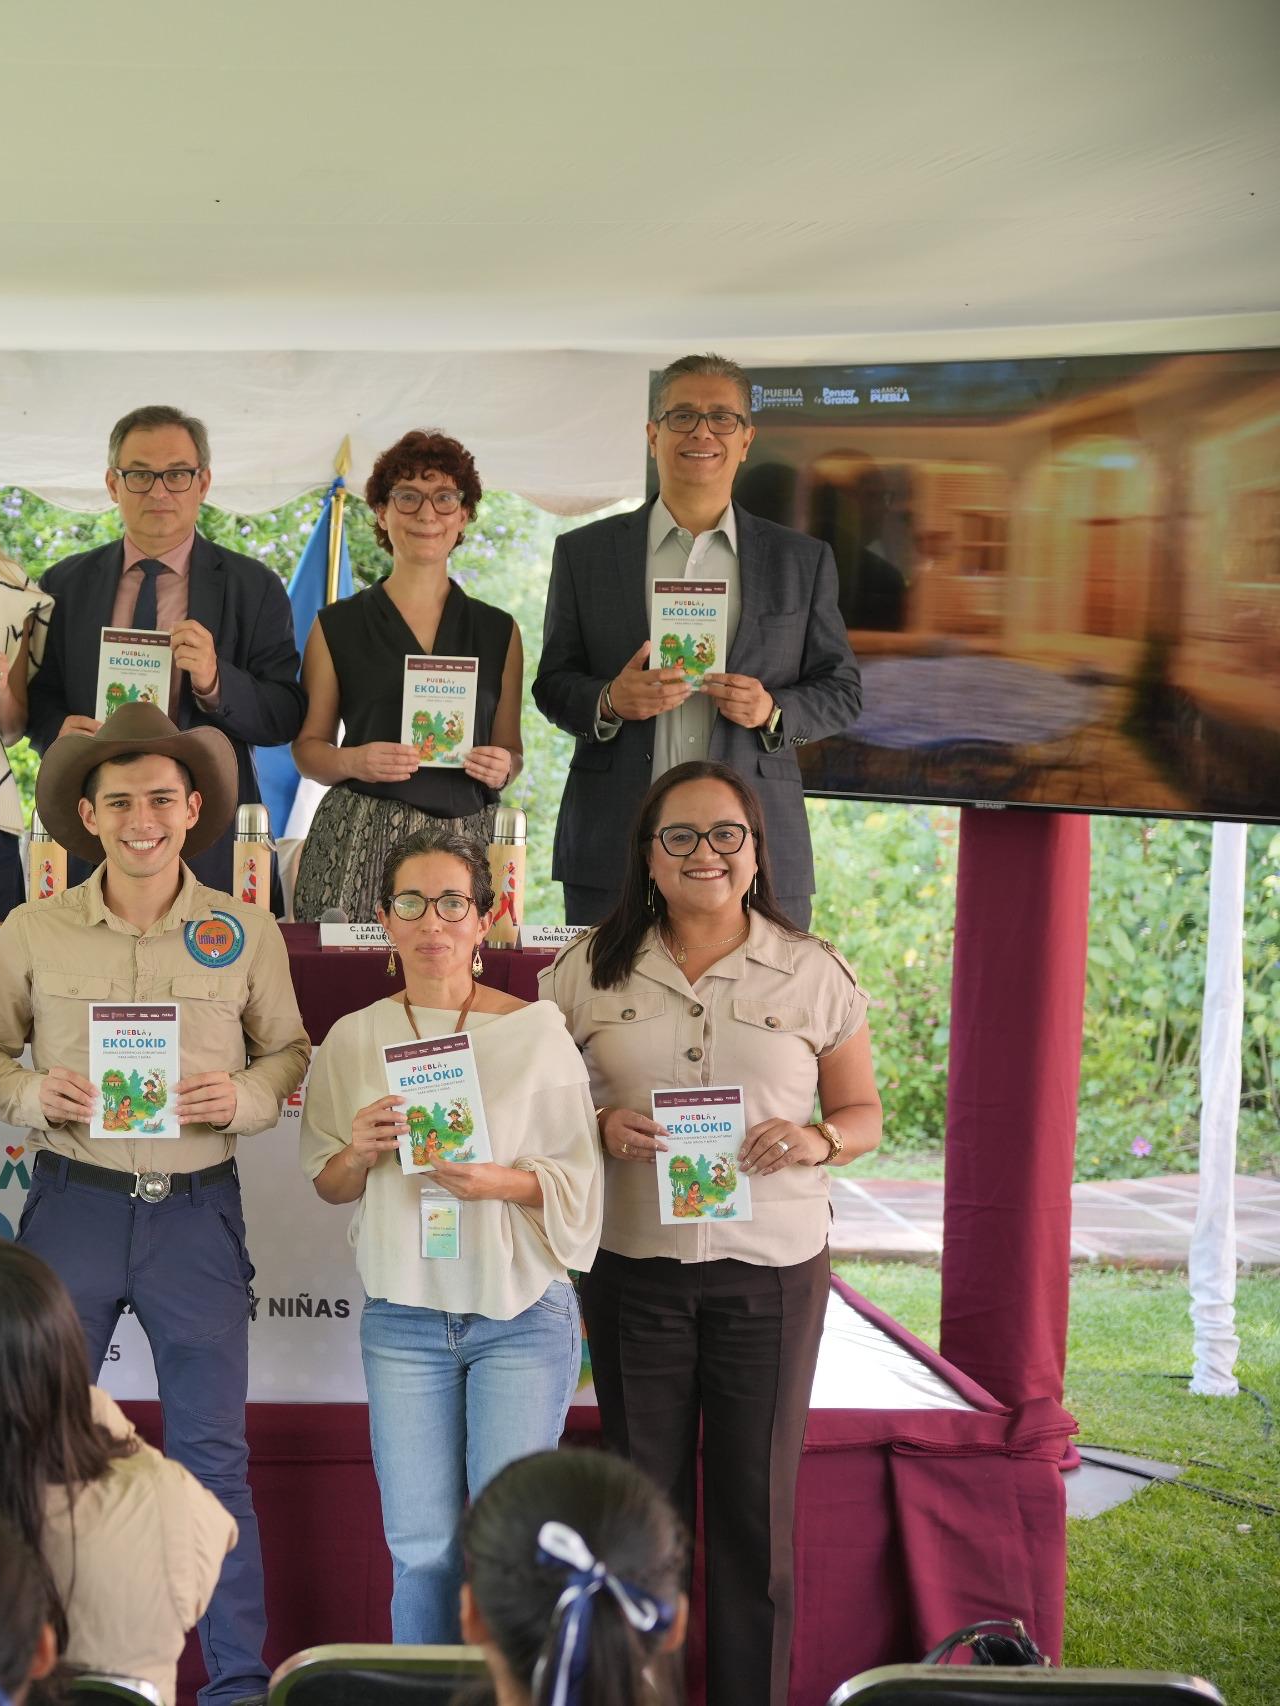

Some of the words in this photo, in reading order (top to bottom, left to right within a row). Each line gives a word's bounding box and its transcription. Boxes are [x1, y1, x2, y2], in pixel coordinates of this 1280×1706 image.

[763, 388, 803, 398] PUEBLA
[823, 387, 856, 398] Pensar
[823, 396, 859, 405] Grande
[870, 393, 909, 403] PUEBLA
[662, 607, 717, 617] EKOLOKID
[109, 657, 161, 668] EKOLOKID
[414, 684, 466, 694] EKOLOKID
[542, 926, 552, 934] C.
[533, 934, 569, 942] RAMÍREZ
[102, 1038, 166, 1048] EKOLOKID
[412, 1061, 443, 1073] PUEBLA
[399, 1067, 464, 1087] EKOLOKID
[680, 1113, 711, 1121] PUEBLA
[667, 1122, 732, 1134] EKOLOKID
[269, 1293, 350, 1319] NIÑAS
